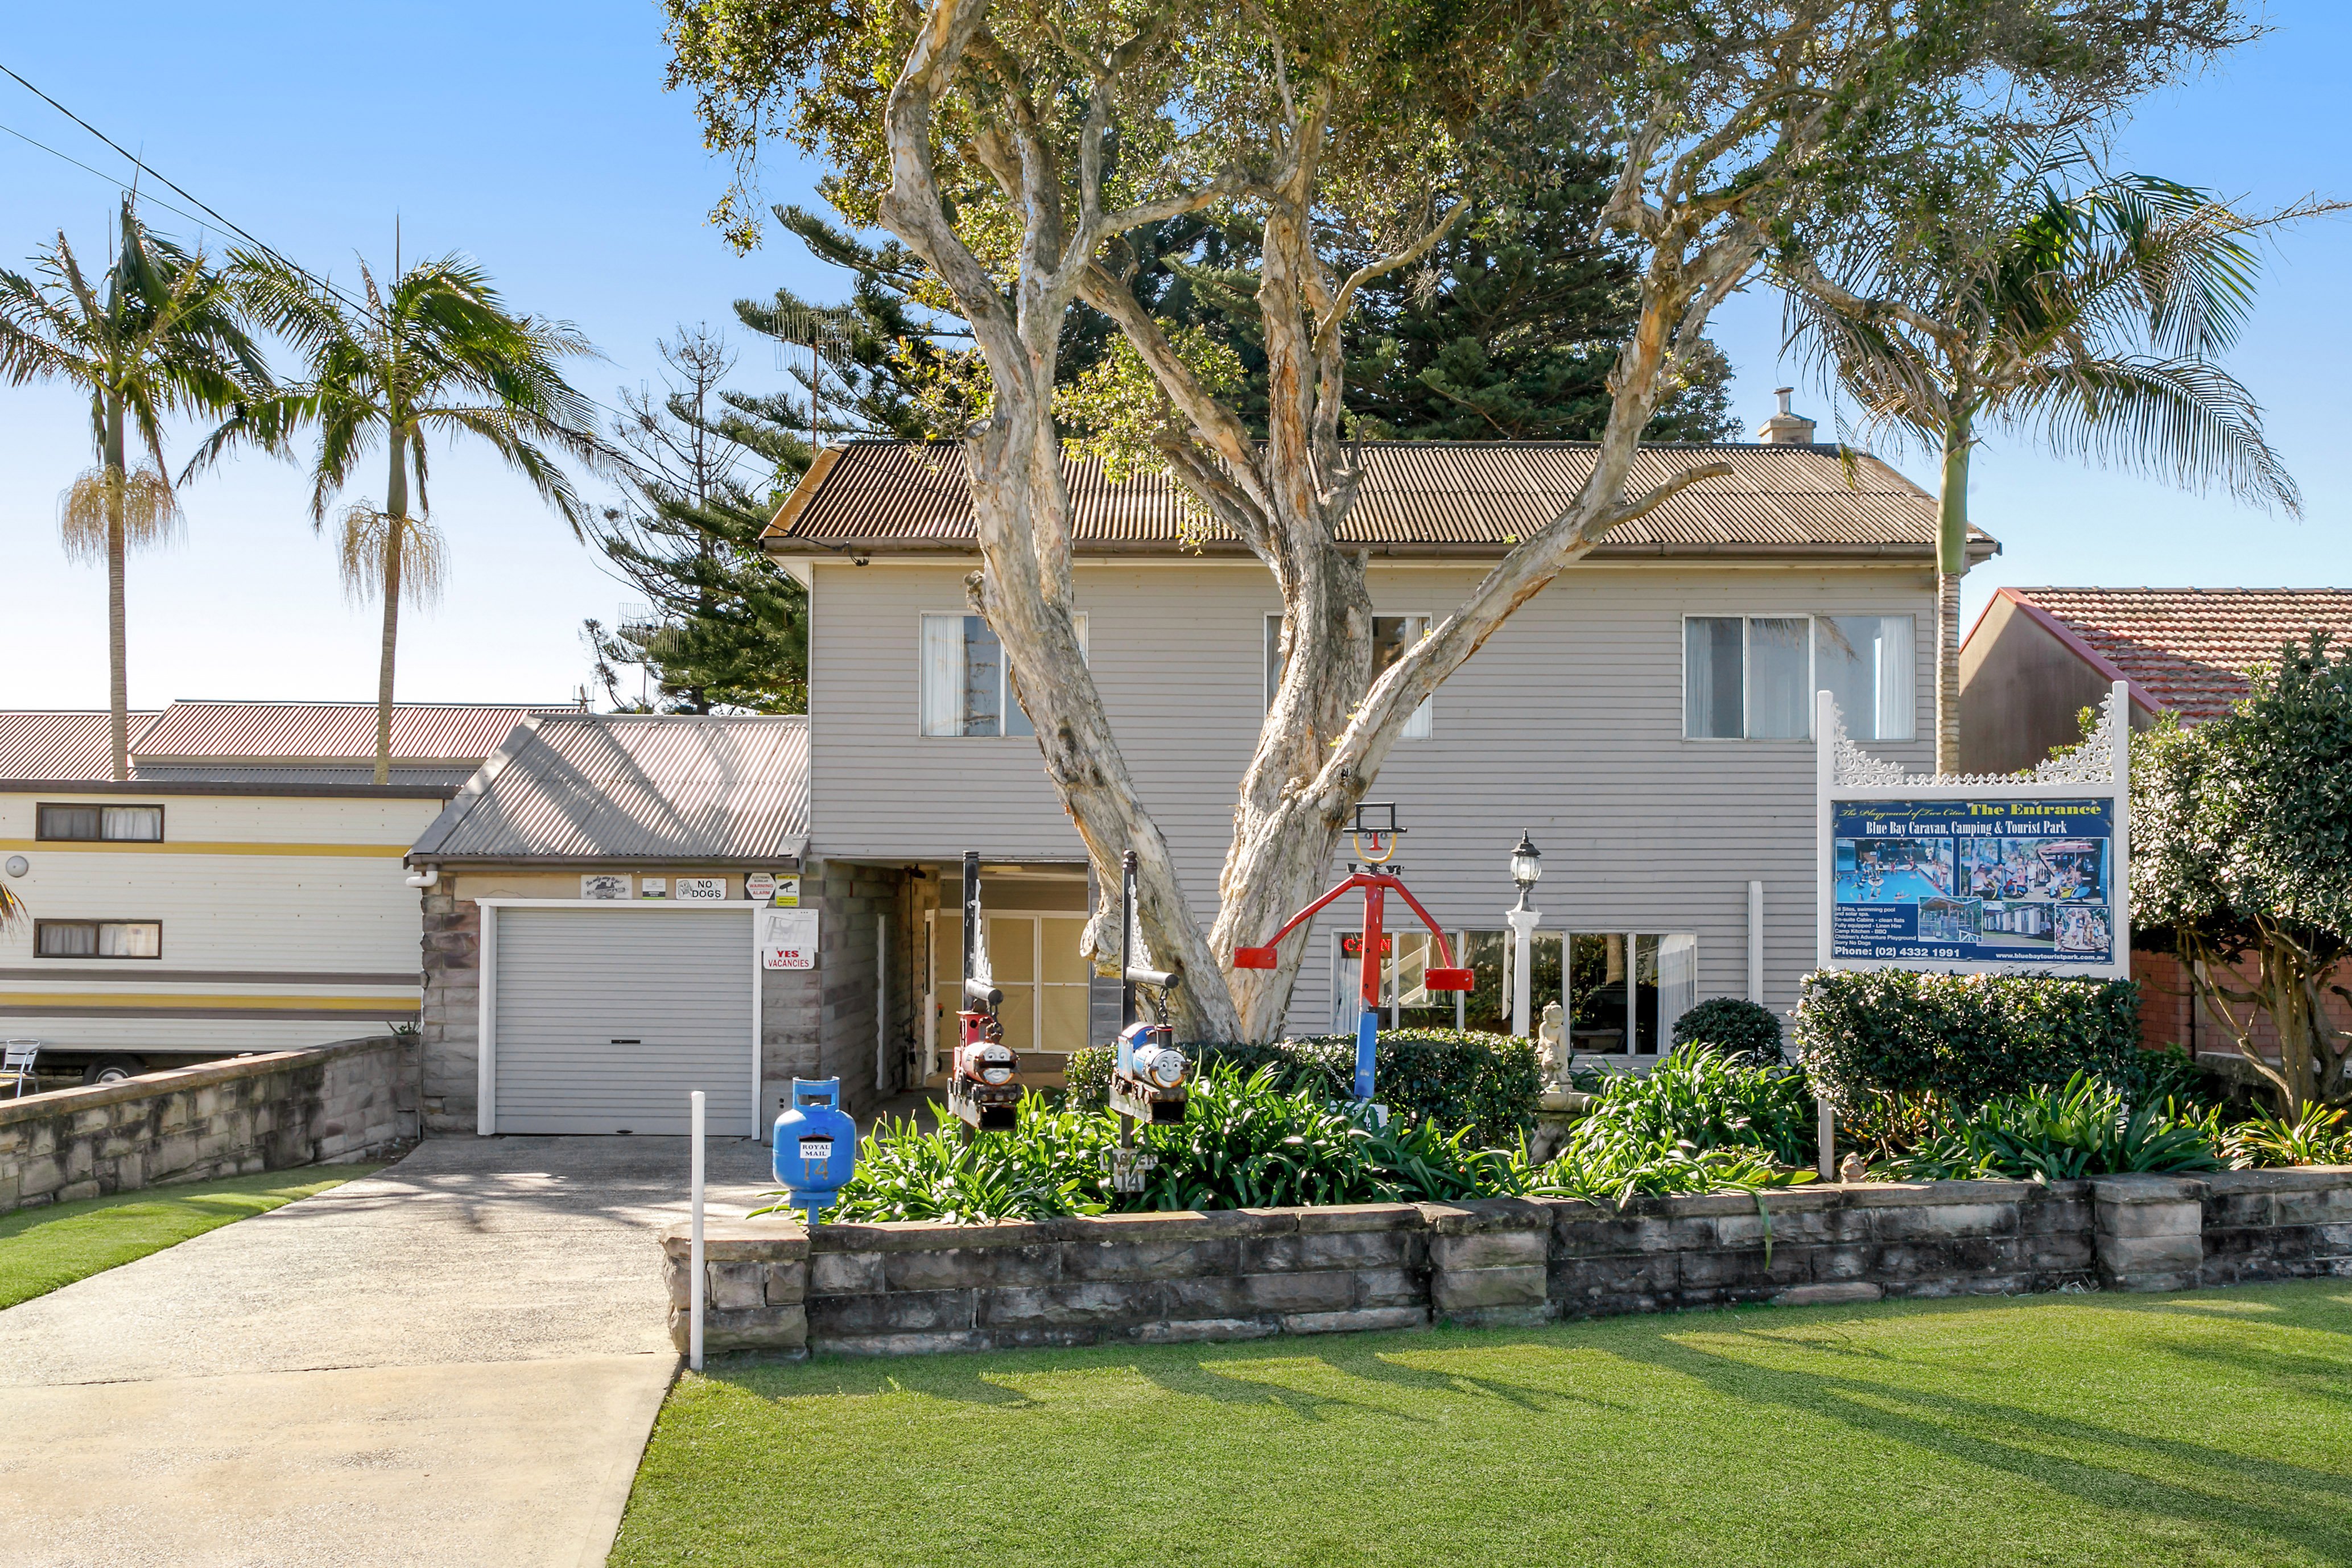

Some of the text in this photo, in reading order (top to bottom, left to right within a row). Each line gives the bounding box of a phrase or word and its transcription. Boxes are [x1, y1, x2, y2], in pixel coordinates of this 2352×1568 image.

[1859, 808, 1912, 820] Playground
[1911, 807, 1922, 820] of
[1970, 803, 2004, 815] The
[2010, 804, 2102, 815] Entrance
[1866, 820, 2067, 837] Blue Bay Caravan, Camping & Tourist Park
[1835, 947, 1959, 957] Phone: (02) 4332 1991
[1996, 952, 2105, 961] www.bluebaytouristpark.com.au
[804, 1158, 828, 1181] 14
[1121, 1171, 1140, 1191] 14
